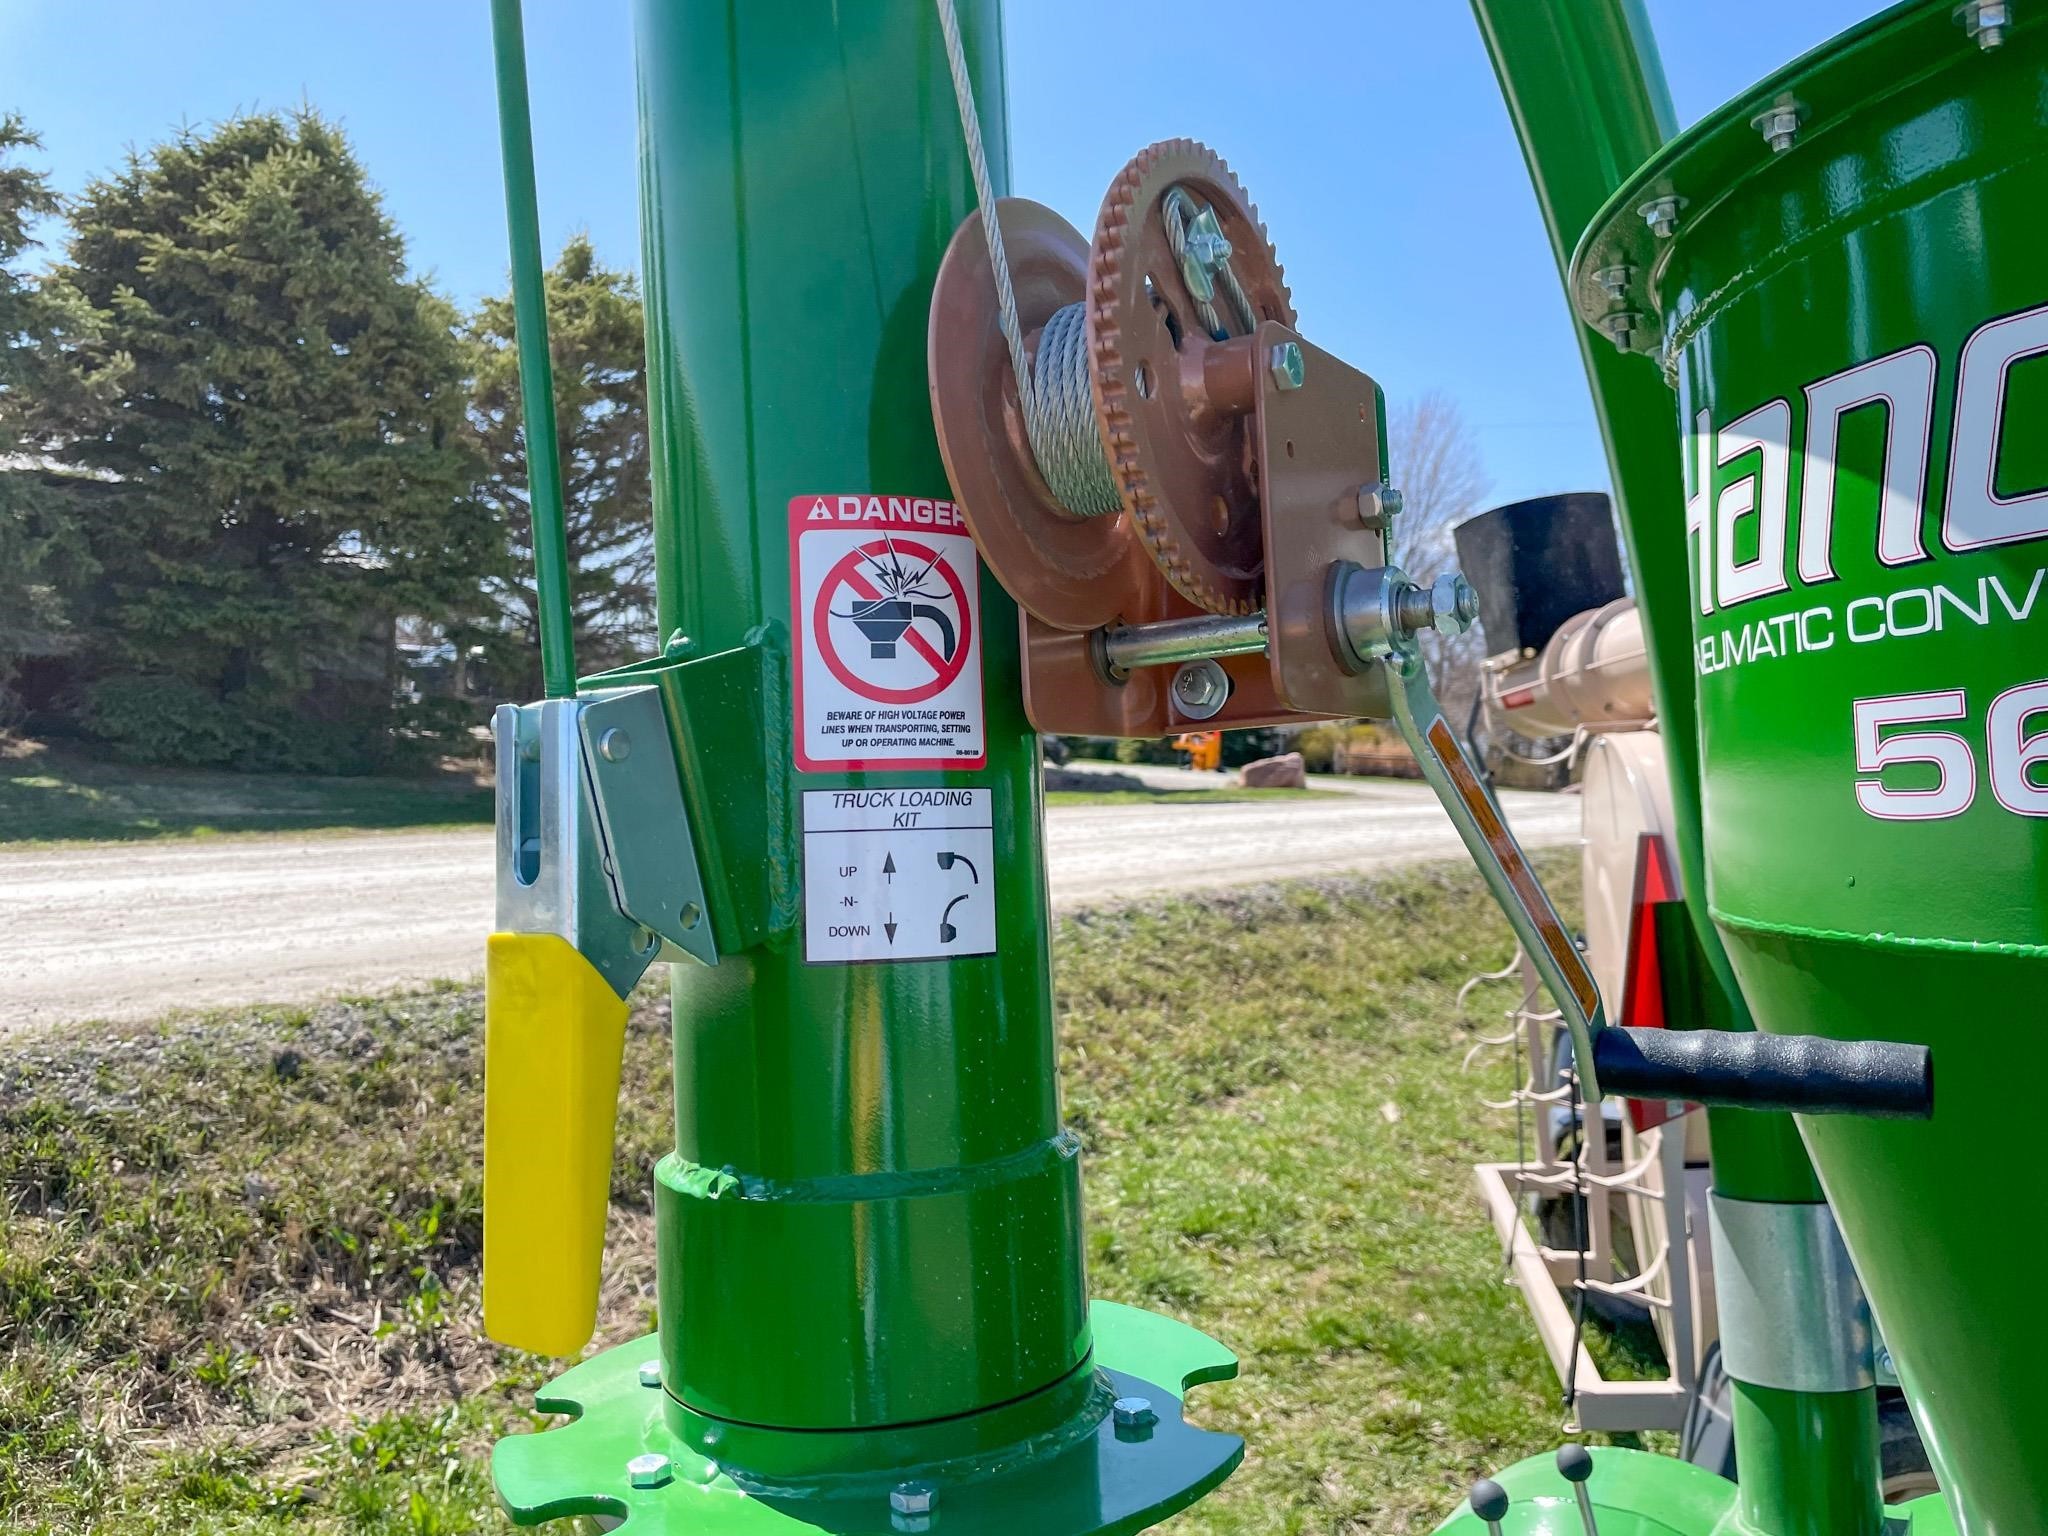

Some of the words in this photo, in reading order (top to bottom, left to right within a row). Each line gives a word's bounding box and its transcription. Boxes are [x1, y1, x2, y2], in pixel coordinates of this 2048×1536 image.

[827, 711, 862, 720] BEWARE
[865, 711, 876, 720] OF
[878, 711, 899, 719] HIGH
[902, 710, 938, 719] VOLTAGE
[939, 711, 966, 720] POWER
[821, 725, 845, 734] LINES
[848, 725, 872, 733] WHEN
[875, 724, 939, 734] TRANSPORTING,
[941, 725, 971, 733] SETTING
[842, 739, 854, 747] UP
[856, 739, 868, 747] OR
[870, 738, 917, 747] OPERATING
[919, 738, 955, 747] MACHINE.
[833, 792, 895, 809] TRUCK
[900, 791, 973, 807] LOADING
[893, 812, 921, 827] KIT
[839, 866, 858, 877] UP
[839, 896, 858, 907] -N-
[828, 925, 870, 937] DOWN
